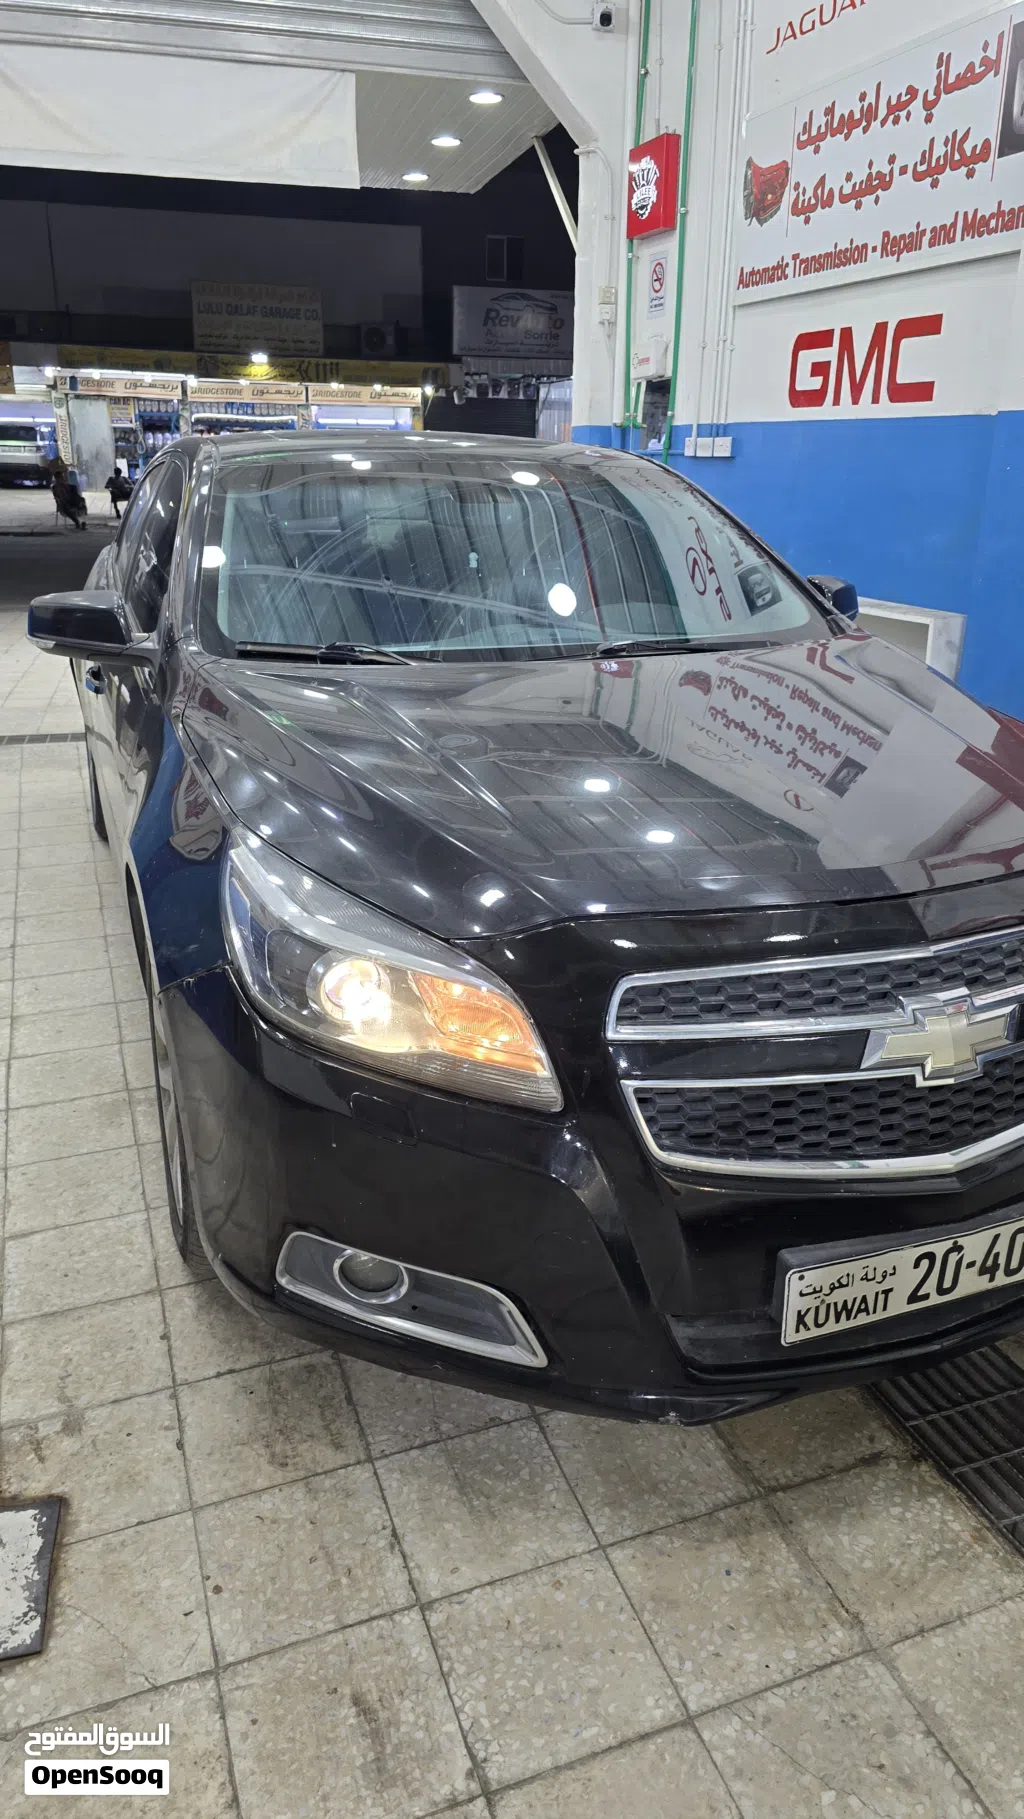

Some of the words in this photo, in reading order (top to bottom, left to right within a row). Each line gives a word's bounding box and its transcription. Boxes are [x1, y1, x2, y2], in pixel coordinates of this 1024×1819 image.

[766, 0, 866, 54] JAGUA
[796, 81, 881, 154] اوتوماتيك
[880, 83, 919, 128] جير
[912, 127, 992, 189] ميكانيك
[791, 174, 834, 225] ماكينة
[737, 255, 789, 290] Automatic
[791, 238, 868, 278] Transmission
[880, 221, 926, 262] Repair
[927, 211, 959, 248] and
[960, 199, 1024, 241] Mechan
[197, 300, 223, 315] LULU
[261, 305, 302, 320] GARAGE
[788, 313, 944, 408] GMC
[124, 380, 179, 392] بريجستون
[190, 387, 244, 396] BRIDGESTONE
[251, 386, 303, 398] بريجستون
[312, 388, 362, 399] BRIDGESTONE
[369, 388, 419, 400] بريجستون
[798, 1273, 854, 1302] الكويت
[860, 1264, 897, 1284] دولة
[794, 1287, 894, 1334] KUWAIT
